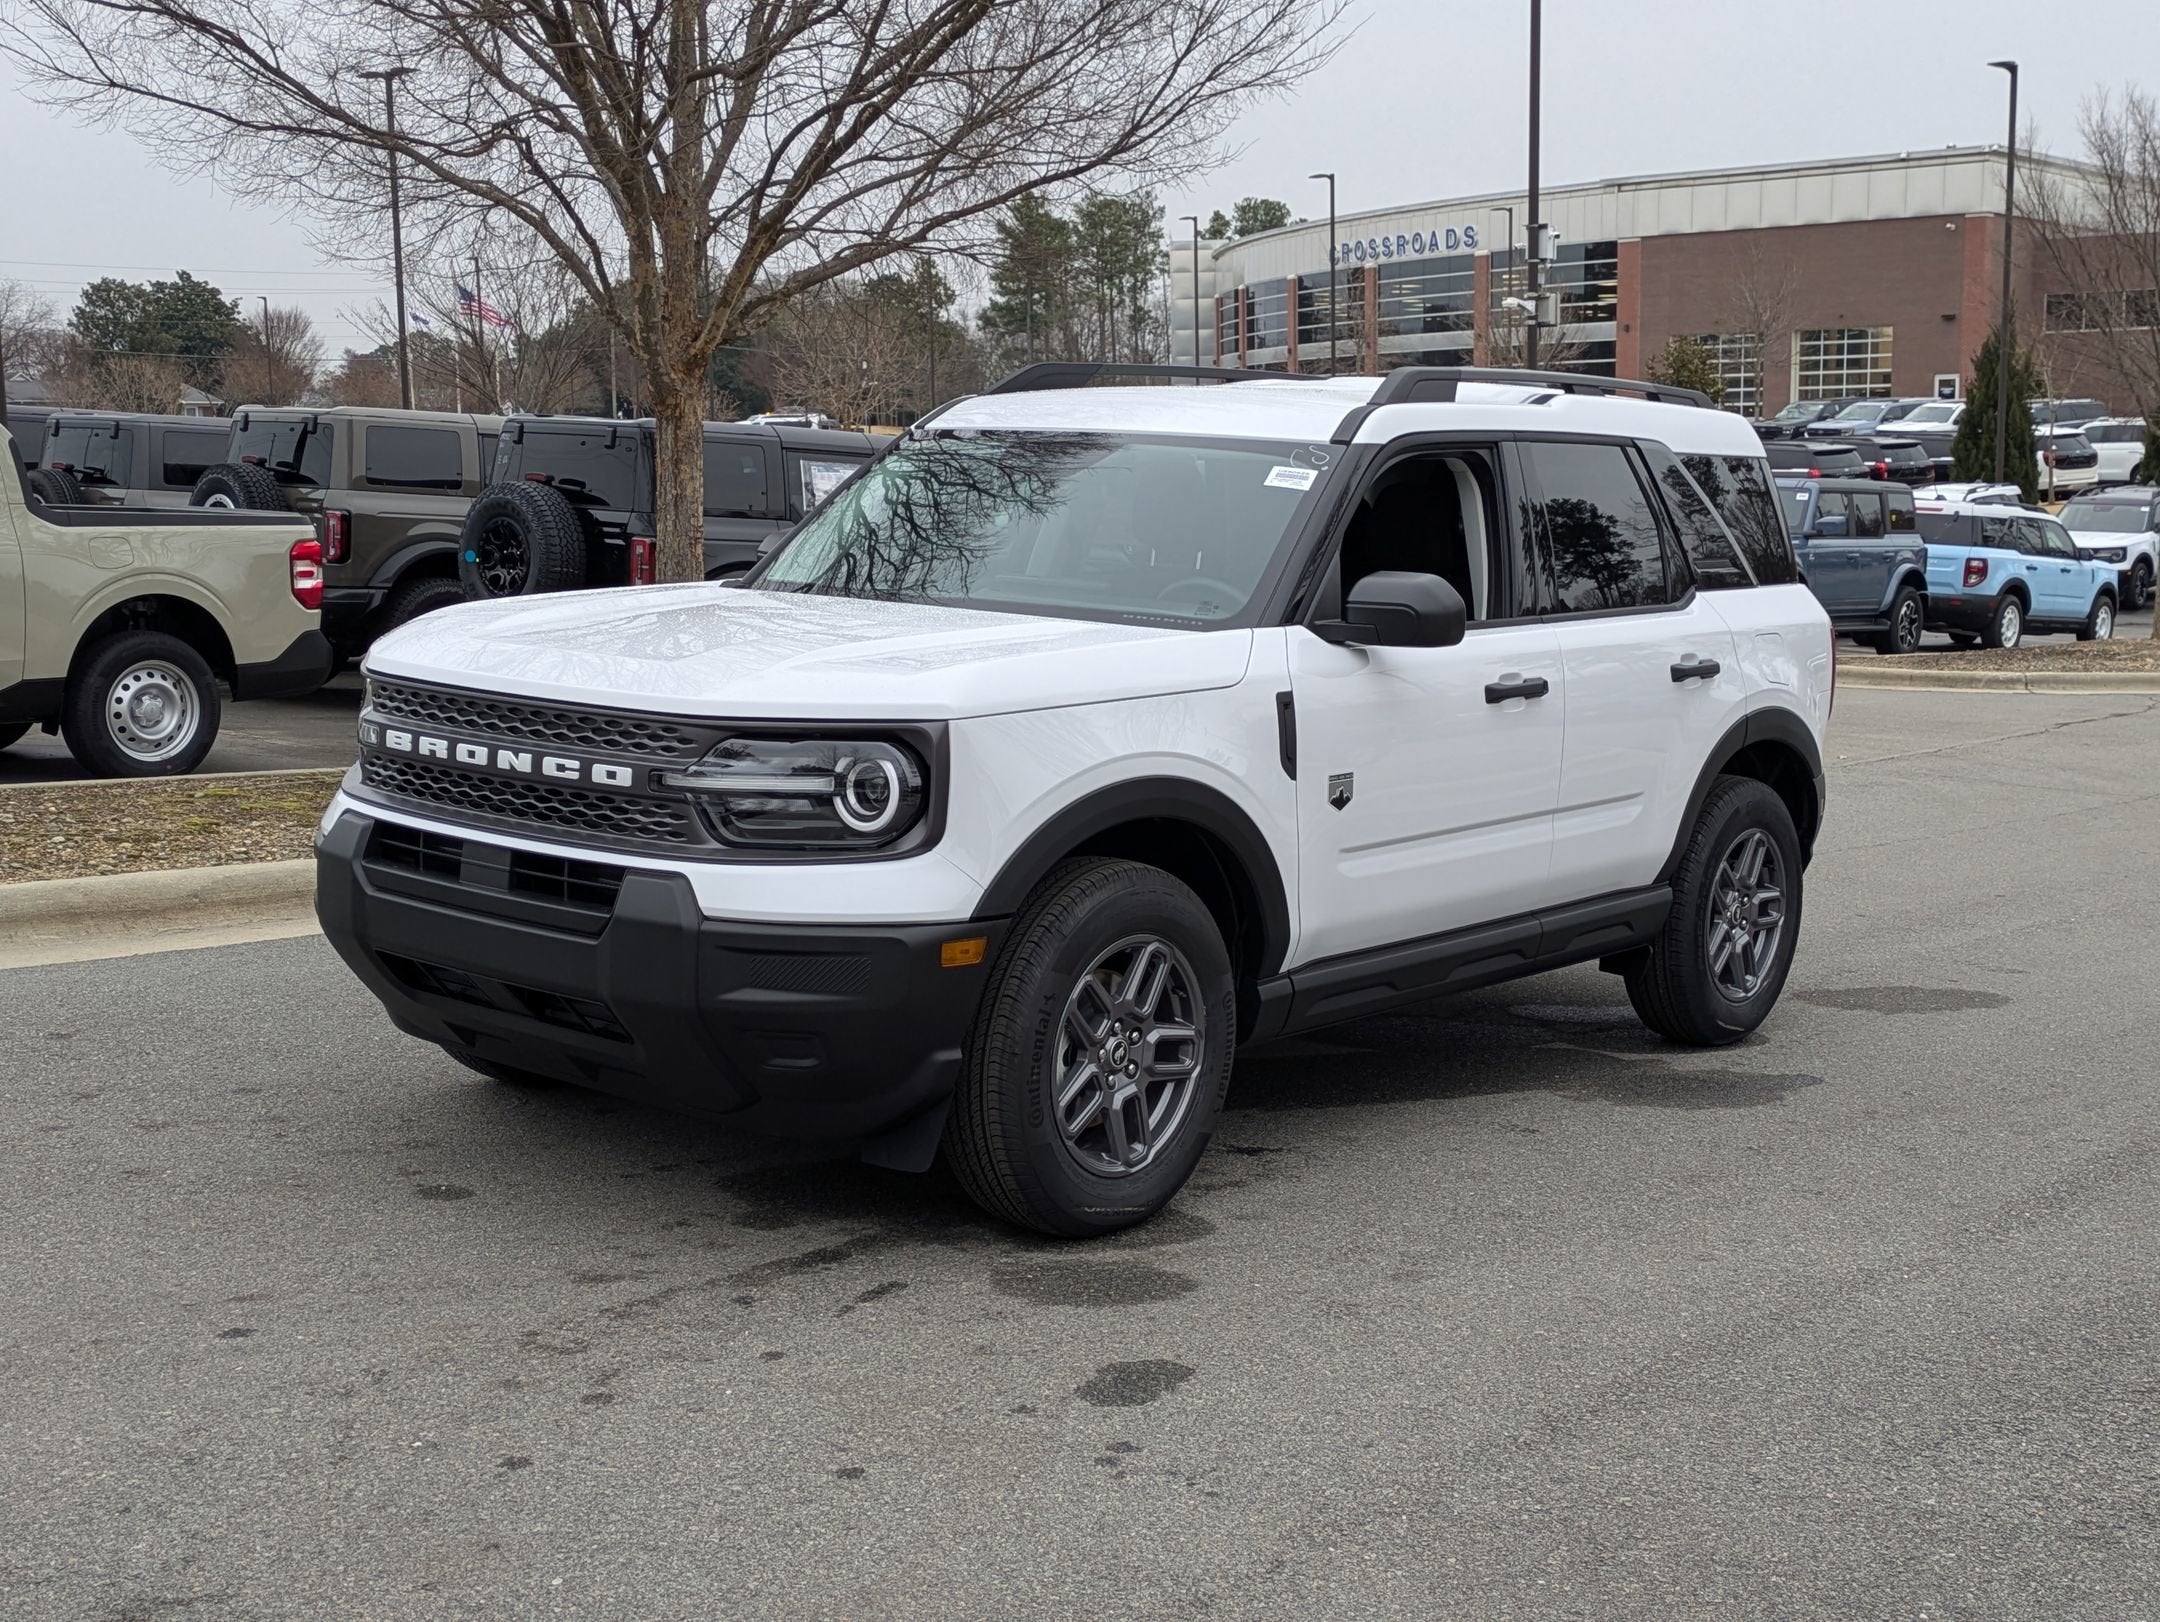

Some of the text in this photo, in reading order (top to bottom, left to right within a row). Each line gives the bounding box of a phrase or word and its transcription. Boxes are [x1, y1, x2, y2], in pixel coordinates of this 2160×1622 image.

[385, 729, 633, 788] BRONCO
[1026, 1008, 1052, 1128] Continental
[1217, 990, 1234, 1100] Continental
